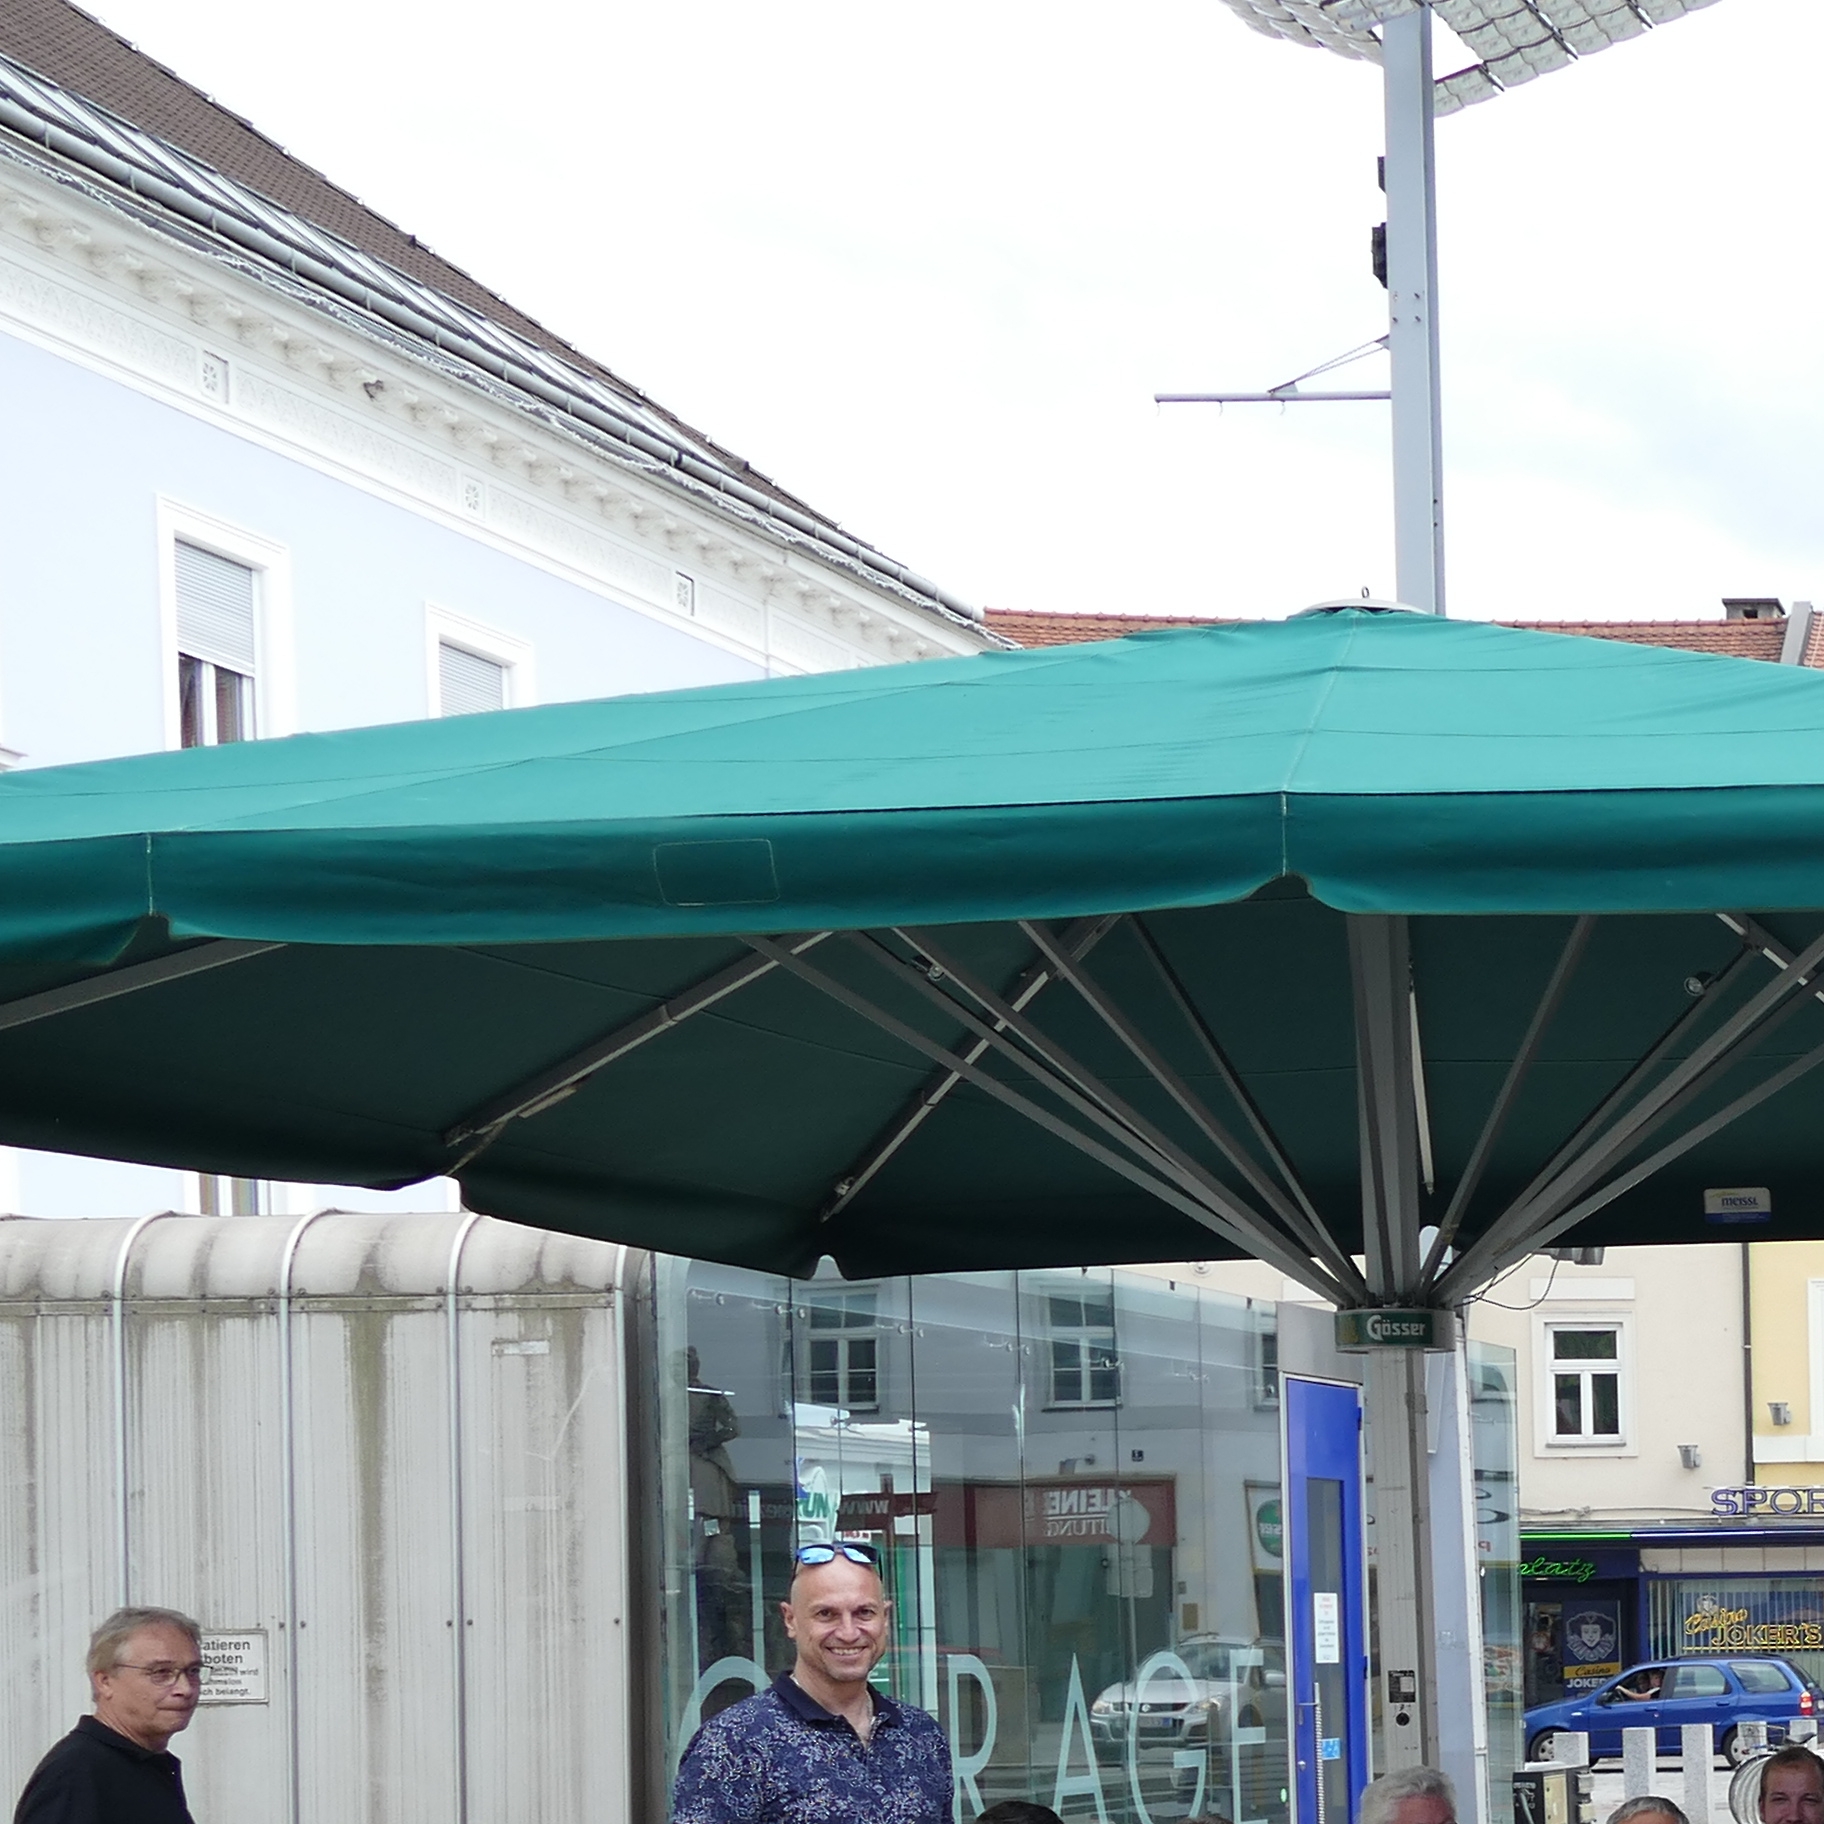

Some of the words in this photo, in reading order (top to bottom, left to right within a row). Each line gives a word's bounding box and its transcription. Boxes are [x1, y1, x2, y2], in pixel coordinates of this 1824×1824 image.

[1366, 1314, 1426, 1341] Gösser
[1711, 1622, 1823, 1646] JOKER'S
[202, 1640, 251, 1651] atieren
[203, 1653, 243, 1664] boten
